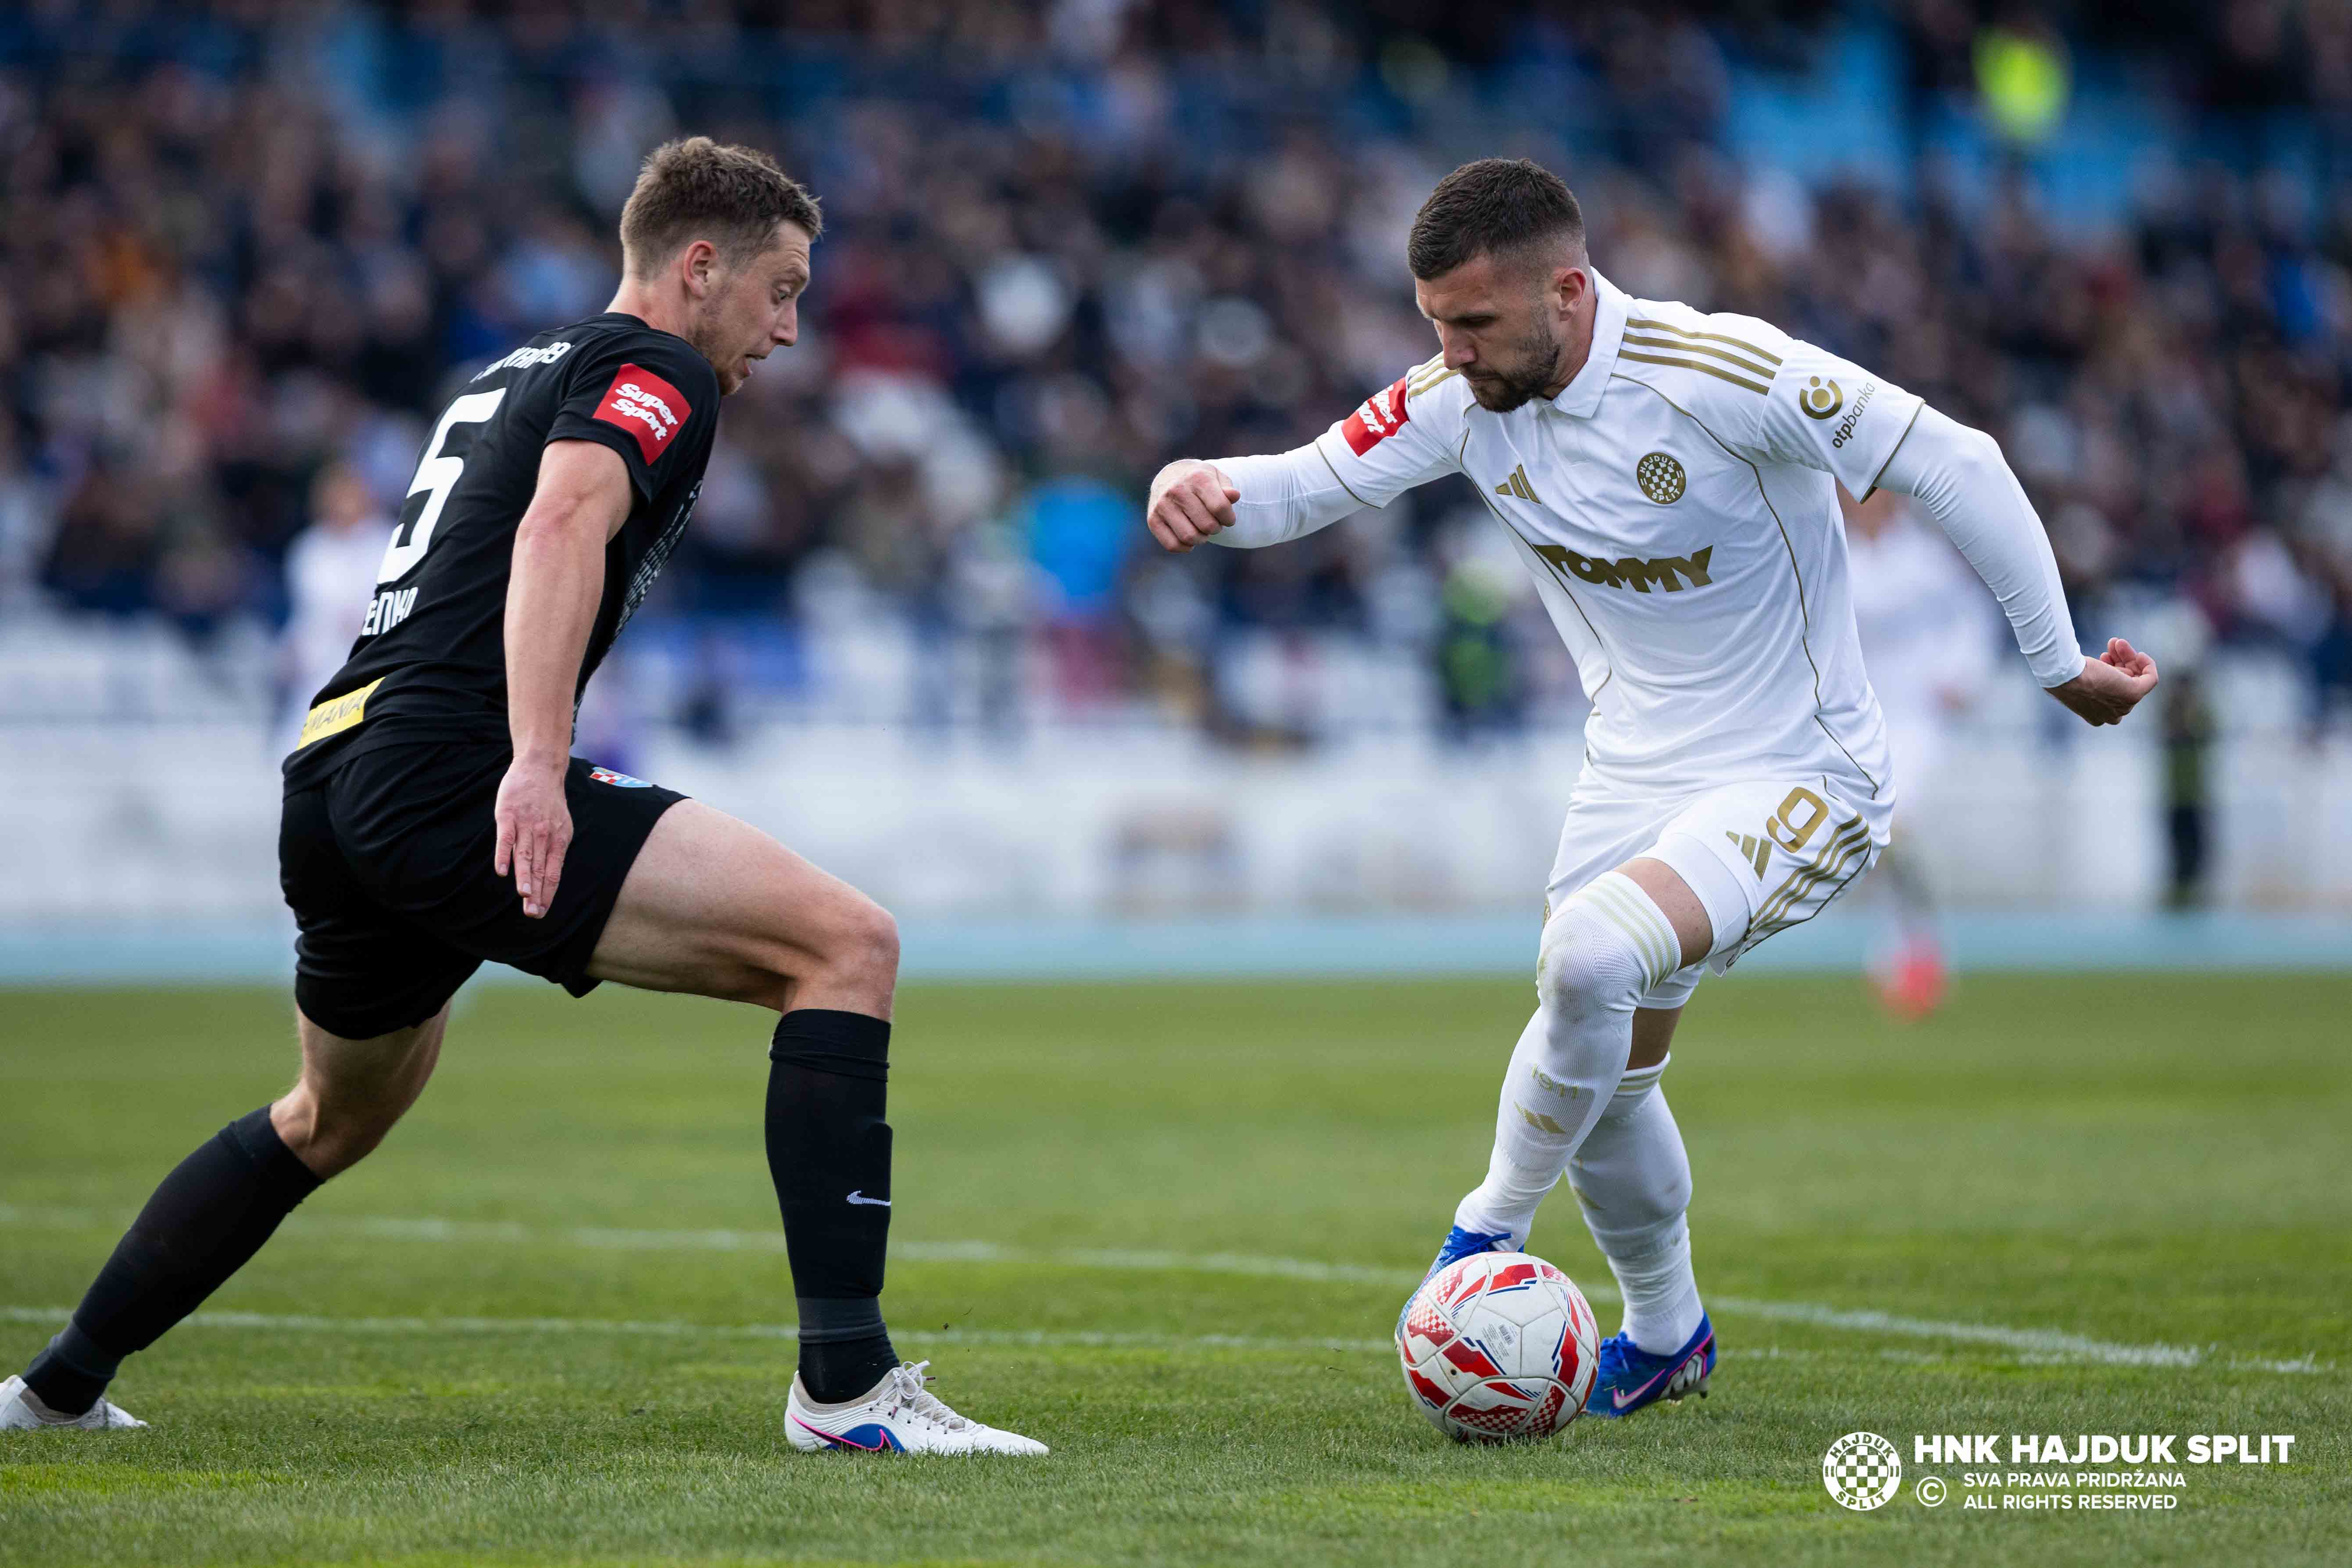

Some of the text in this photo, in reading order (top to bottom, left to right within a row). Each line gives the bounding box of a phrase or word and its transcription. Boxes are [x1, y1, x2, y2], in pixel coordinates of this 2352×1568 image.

[611, 398, 668, 441] Sport
[615, 383, 679, 425] Super
[1639, 455, 1675, 474] HAJDUK
[376, 388, 506, 585] 5
[1651, 488, 1680, 501] SPLIT
[1531, 544, 1714, 594] TOMMY
[1766, 786, 1829, 854] 9
